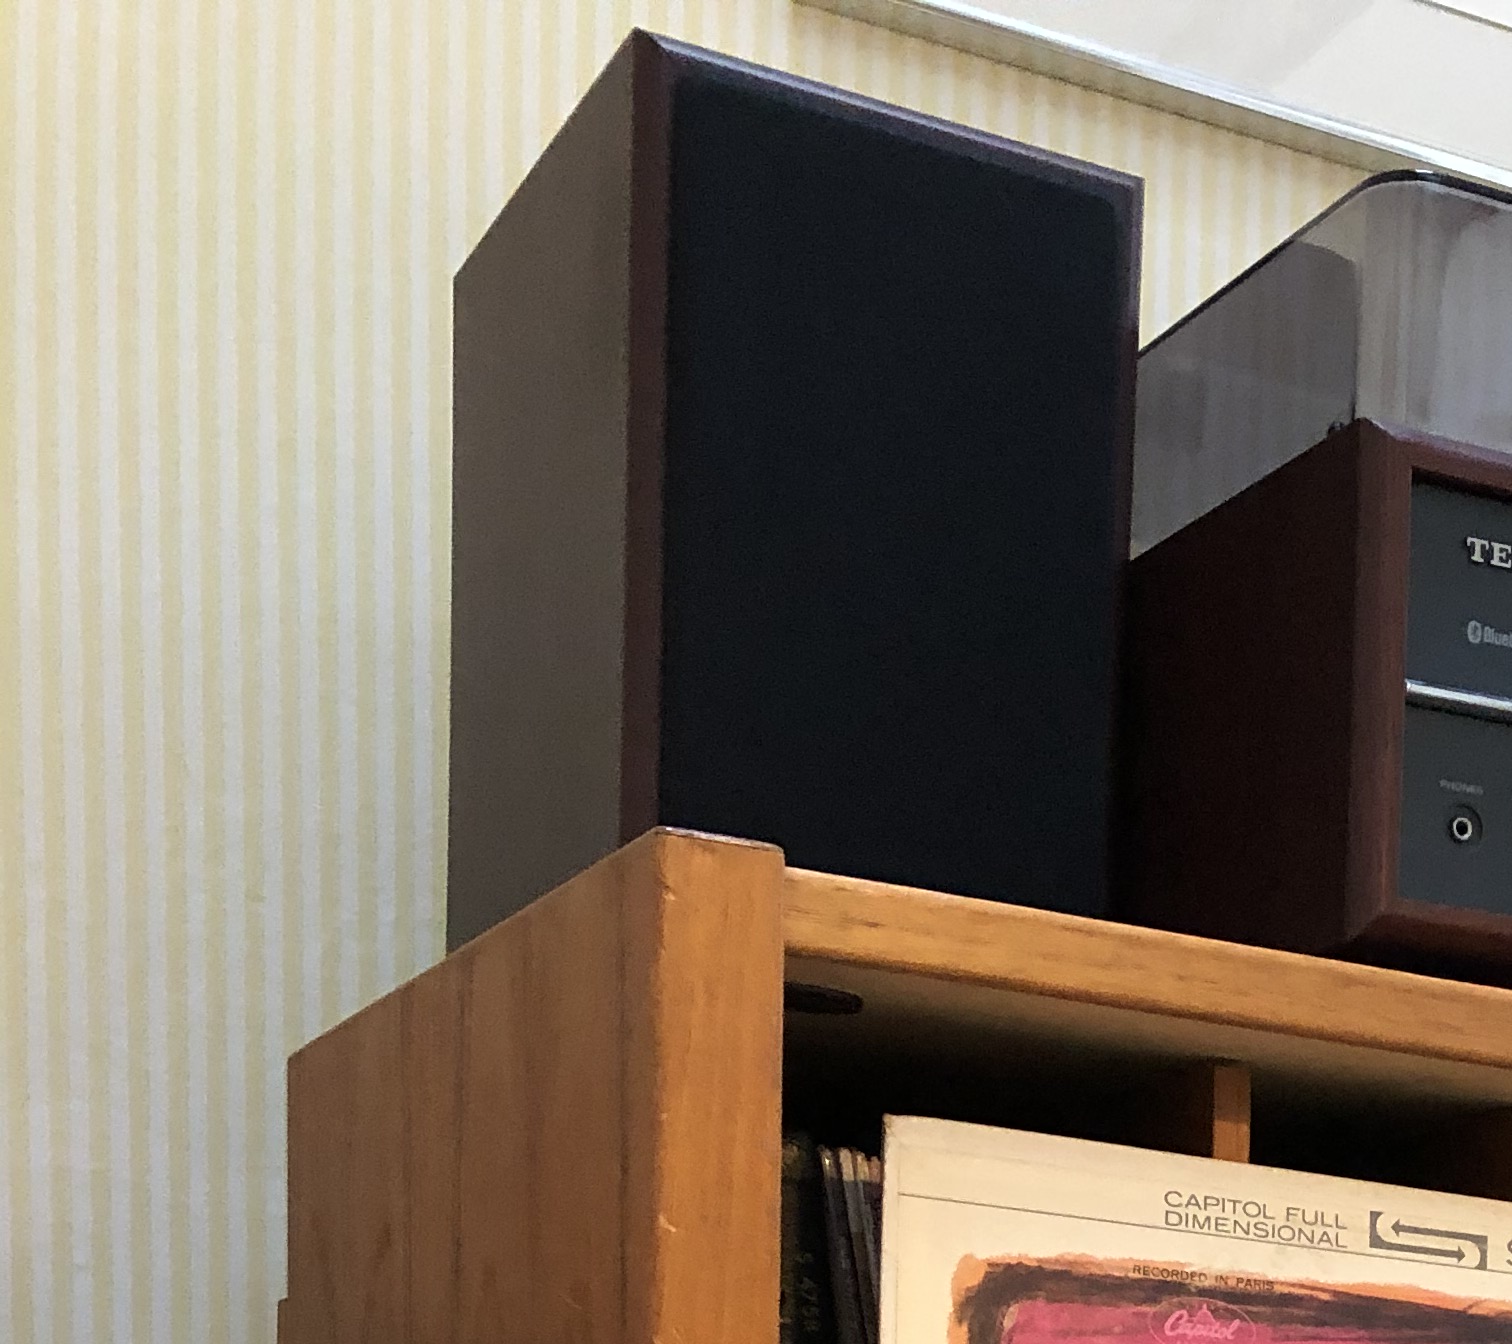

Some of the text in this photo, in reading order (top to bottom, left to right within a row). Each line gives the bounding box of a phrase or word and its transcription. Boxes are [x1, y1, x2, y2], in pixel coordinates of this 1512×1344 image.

[1164, 1191, 1348, 1230] CAPITOL FULL
[1164, 1210, 1348, 1249] DIMENSIONAL
[1132, 1264, 1275, 1292] RECORDED IN PARIS
[1164, 1309, 1241, 1340] Capitol
